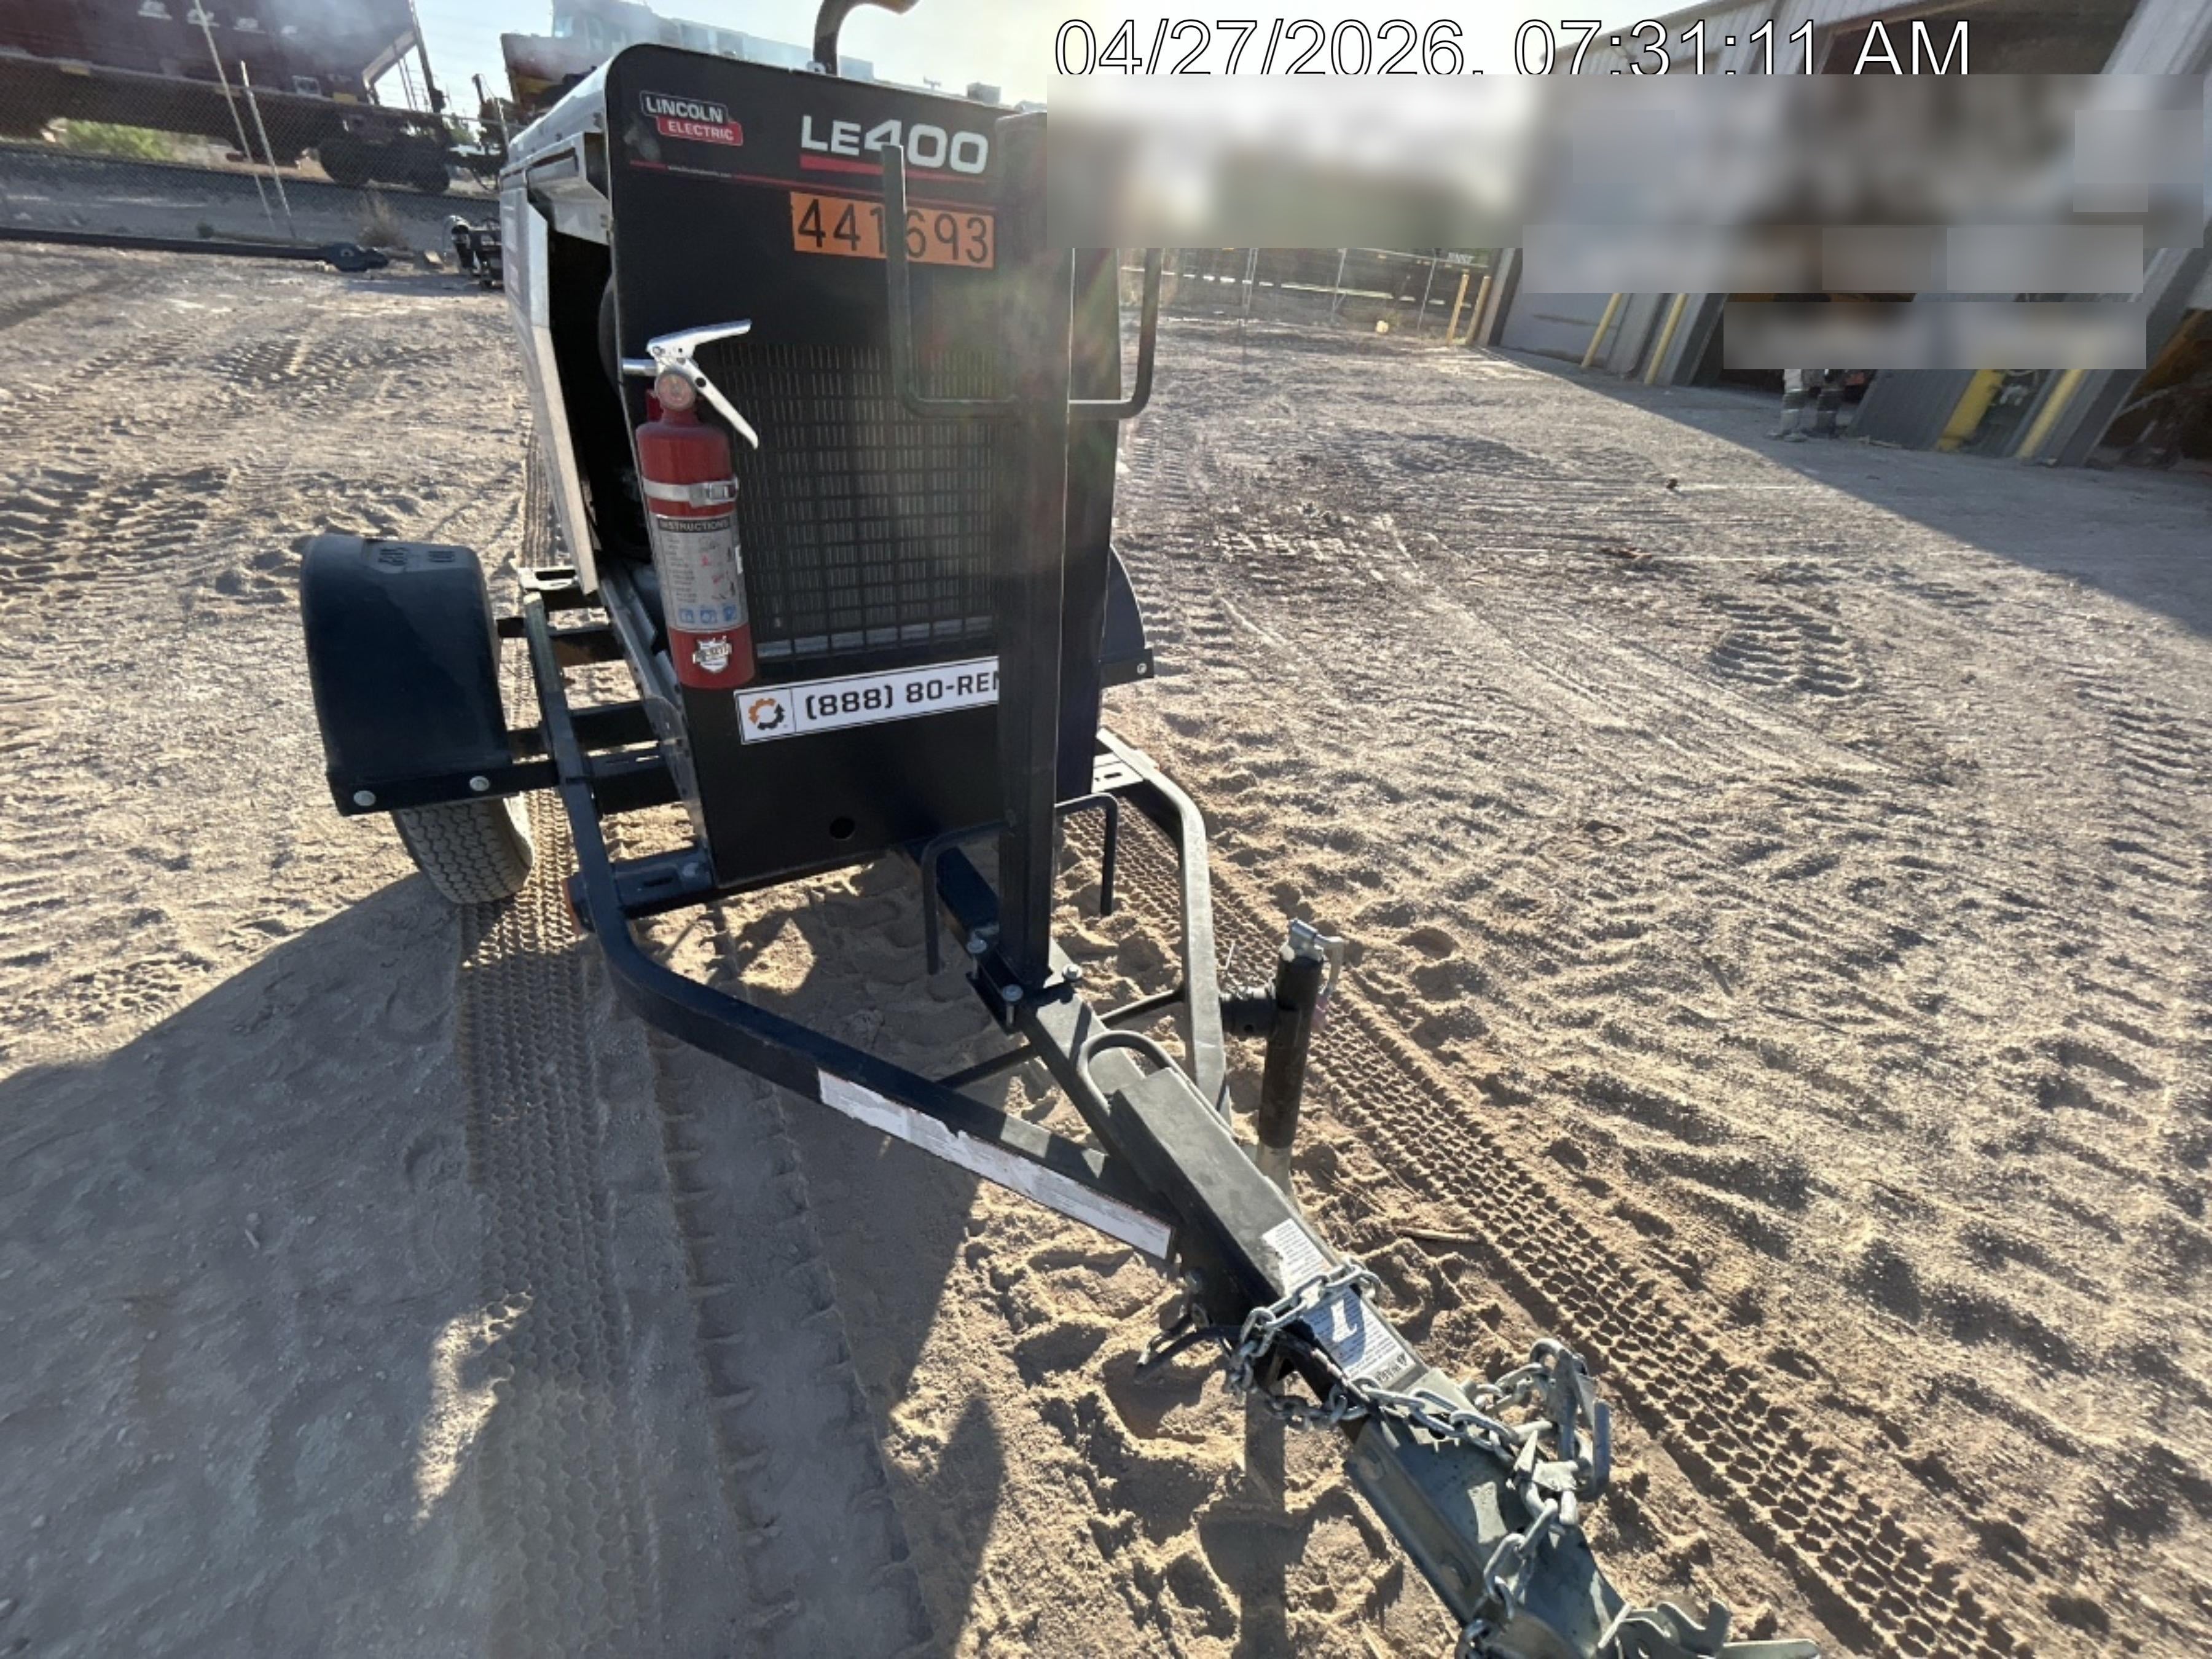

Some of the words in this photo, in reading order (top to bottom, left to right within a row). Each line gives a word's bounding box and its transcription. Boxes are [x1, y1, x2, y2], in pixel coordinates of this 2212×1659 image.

[646, 96, 723, 124] LINCOLN
[668, 120, 734, 141] ELECTRIC
[801, 115, 989, 174] LE400
[798, 198, 988, 263] 441693
[806, 685, 893, 720] (888)
